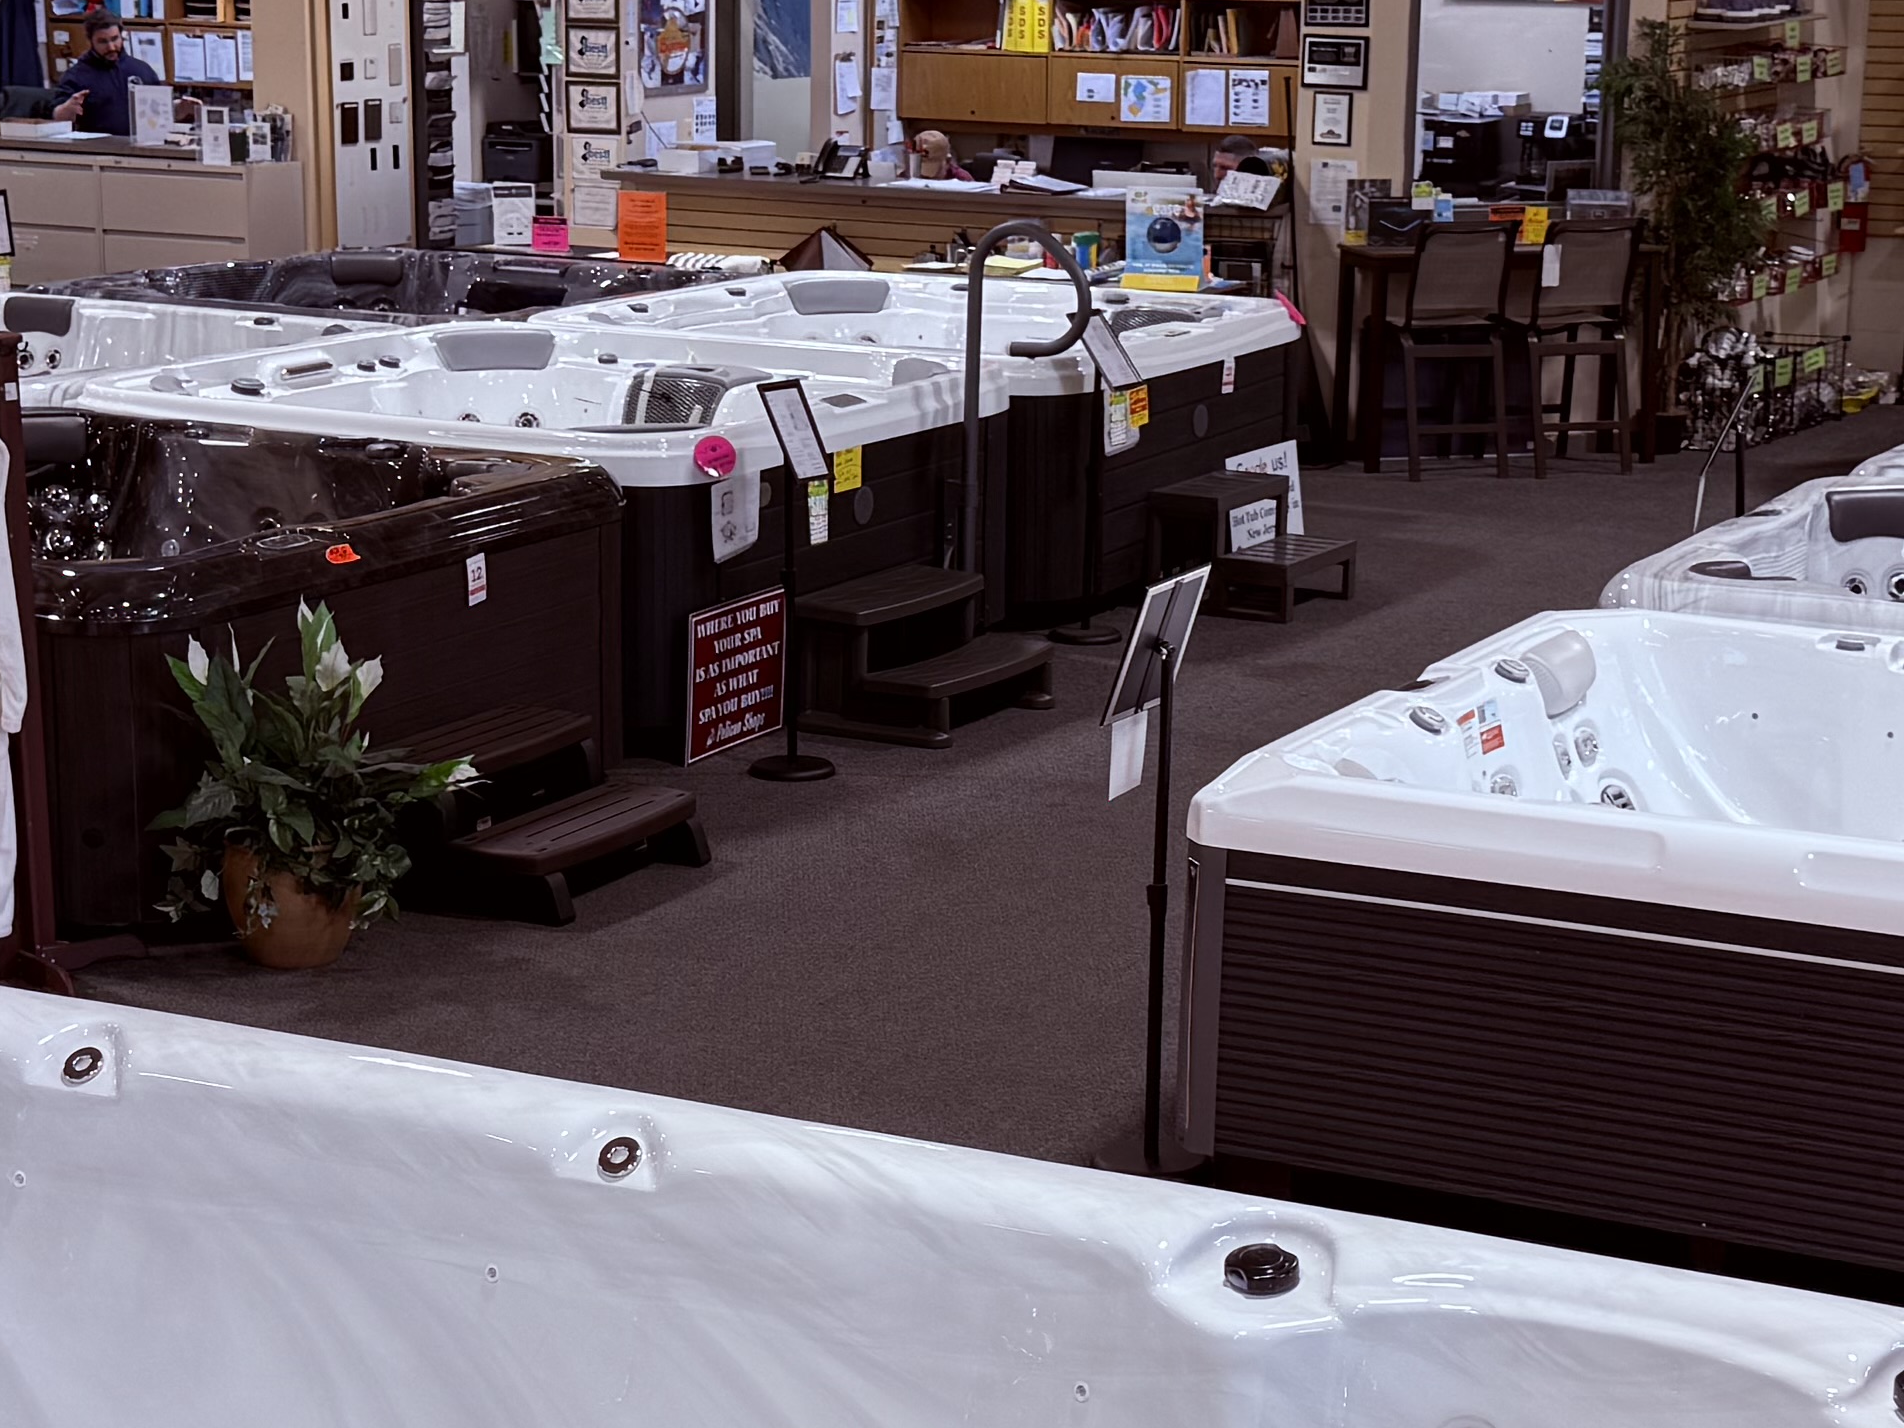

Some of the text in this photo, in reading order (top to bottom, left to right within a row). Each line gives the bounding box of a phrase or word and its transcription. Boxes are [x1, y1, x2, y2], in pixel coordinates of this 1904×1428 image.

[1037, 6, 1046, 40] SDS
[470, 566, 484, 583] 12
[697, 599, 781, 639] WHERE YOU BUY
[714, 626, 763, 655] YOUR SPA
[707, 661, 720, 678] AS
[721, 641, 781, 673] IMPORTANT
[714, 668, 760, 698] AS WHAT
[699, 708, 716, 725] SPA
[717, 697, 739, 718] YOU
